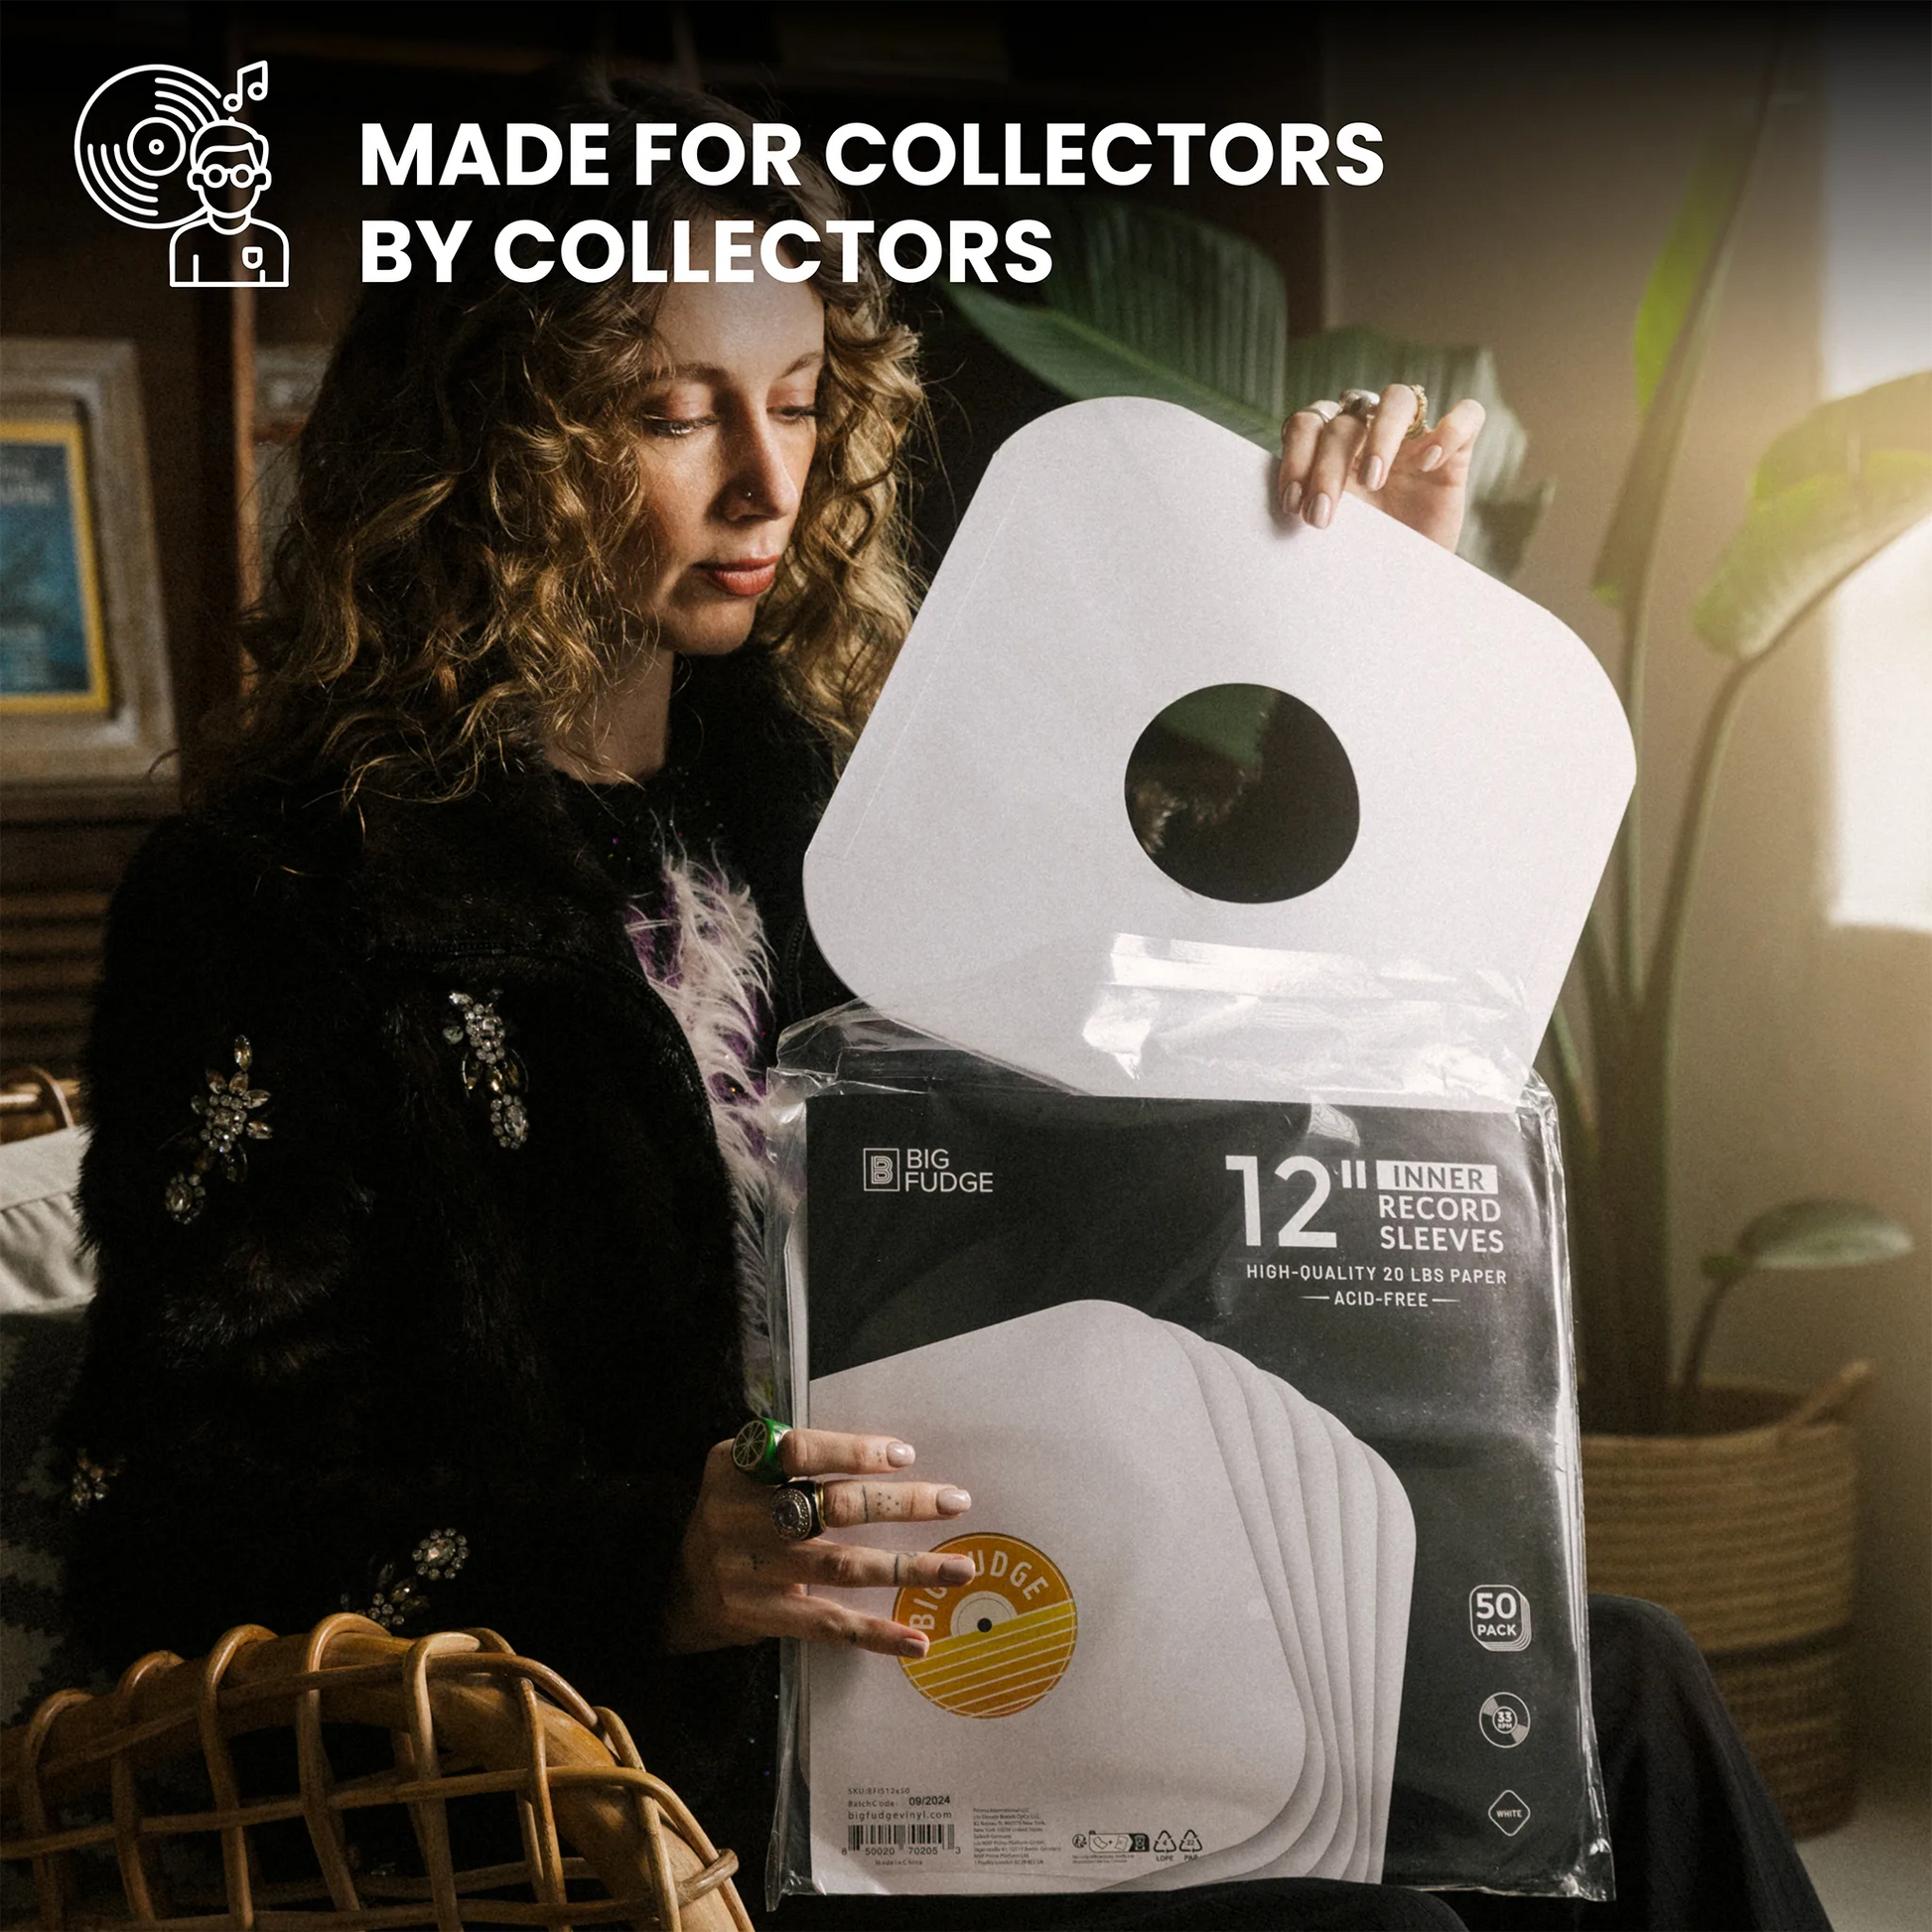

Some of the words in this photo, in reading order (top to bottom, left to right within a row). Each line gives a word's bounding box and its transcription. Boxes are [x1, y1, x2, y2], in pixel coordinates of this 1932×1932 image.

[906, 1149, 950, 1170] BIG
[904, 1172, 994, 1193] FUDGE
[1393, 1165, 1486, 1191] INNER
[1378, 1194, 1502, 1222] RECORD
[1380, 1226, 1505, 1254] SLEEVES
[1246, 1264, 1377, 1282] HIGH-QUALITY
[1383, 1266, 1405, 1282] 20
[1411, 1268, 1445, 1283] LBS
[1449, 1269, 1508, 1285] PAPER
[1333, 1291, 1430, 1308] ACID-FREE
[967, 1549, 1049, 1601] UDGE
[1475, 1592, 1517, 1619] 50
[1476, 1623, 1517, 1636] PACK
[1497, 1711, 1513, 1723] 33
[908, 1795, 951, 1806] 09/2024
[848, 1811, 952, 1822] bigfudgevinyl.com
[1496, 1809, 1523, 1818] WHITE
[841, 1847, 848, 1856] 8
[865, 1847, 896, 1856] 50020
[908, 1847, 938, 1856] 70205
